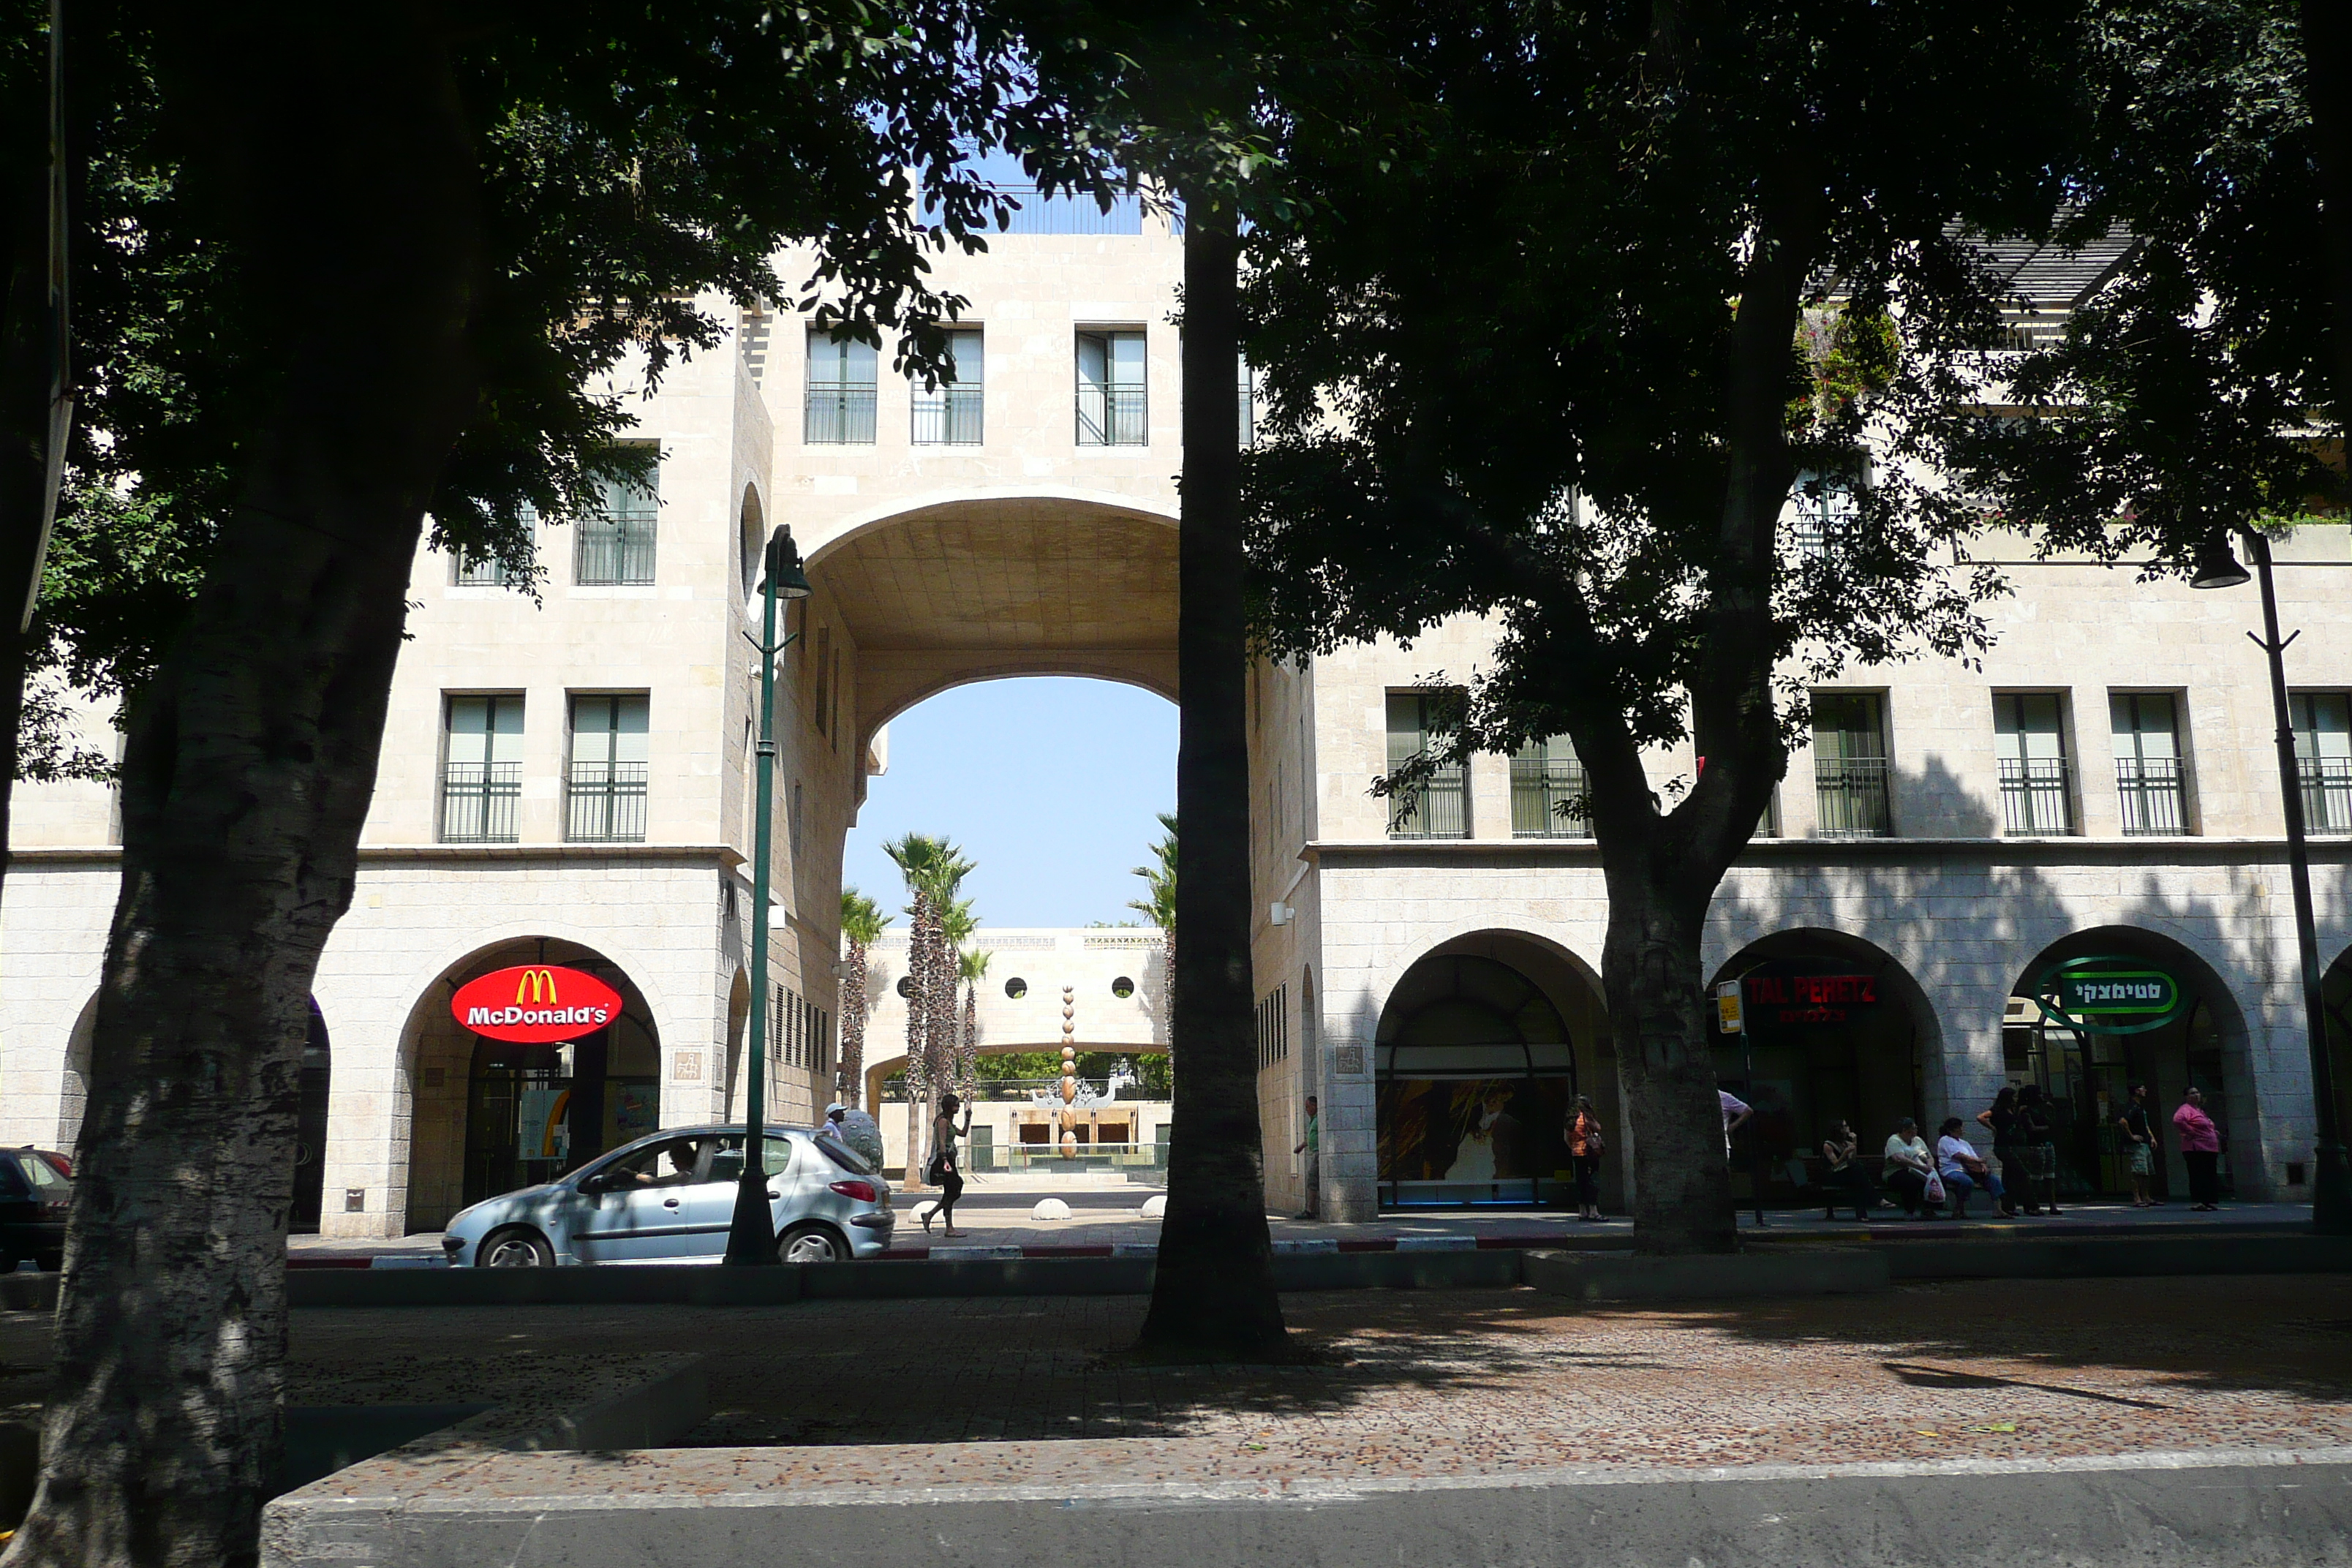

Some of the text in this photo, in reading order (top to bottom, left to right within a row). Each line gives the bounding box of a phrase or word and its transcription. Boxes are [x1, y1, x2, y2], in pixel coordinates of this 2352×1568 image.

[1748, 976, 1877, 1004] TAL PERETZ
[2076, 983, 2161, 1003] סטימצקי
[467, 1006, 607, 1025] McDonald's
